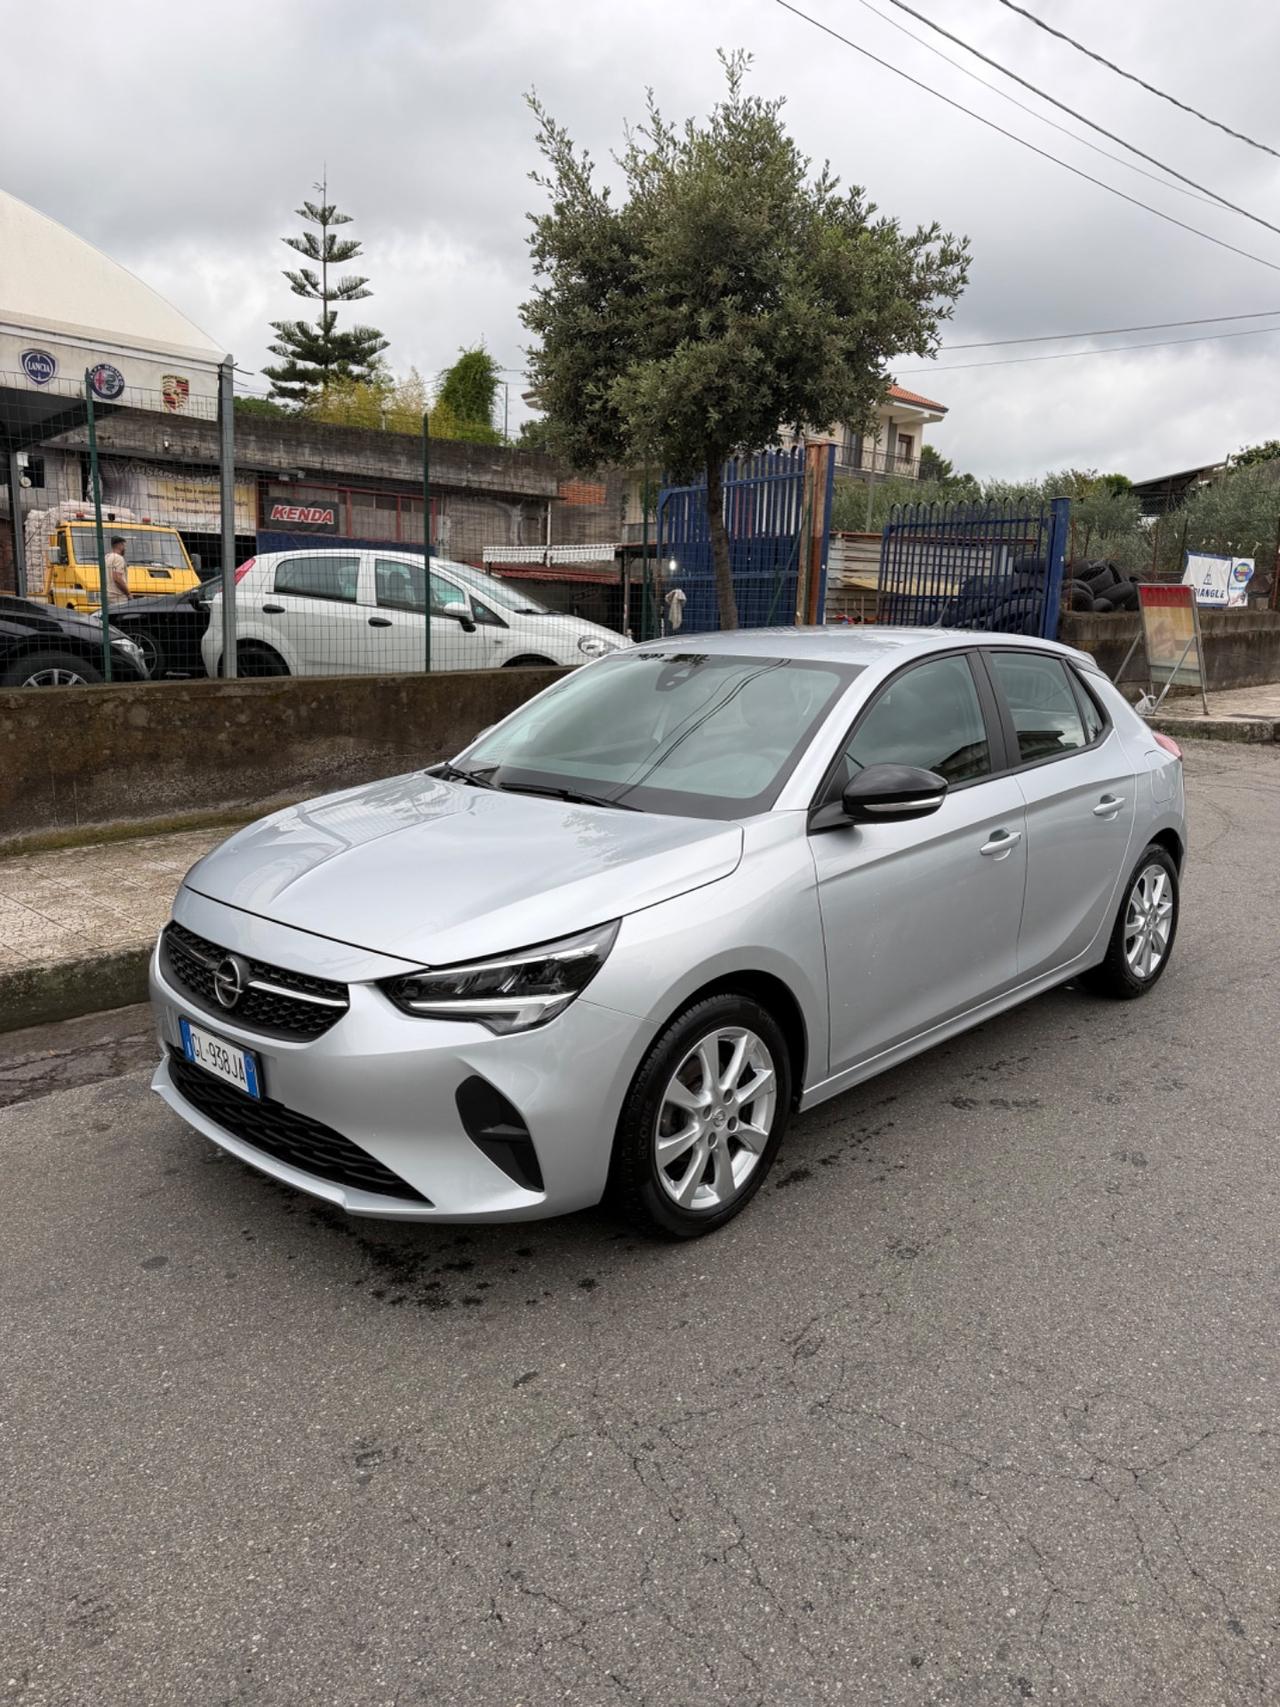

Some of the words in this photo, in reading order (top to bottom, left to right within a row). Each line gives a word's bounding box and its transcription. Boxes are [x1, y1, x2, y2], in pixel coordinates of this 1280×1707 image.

[28, 360, 51, 373] LANCIA
[270, 505, 334, 525] KENDA
[1194, 588, 1225, 600] IANGLE
[208, 1042, 246, 1083] 938JA
